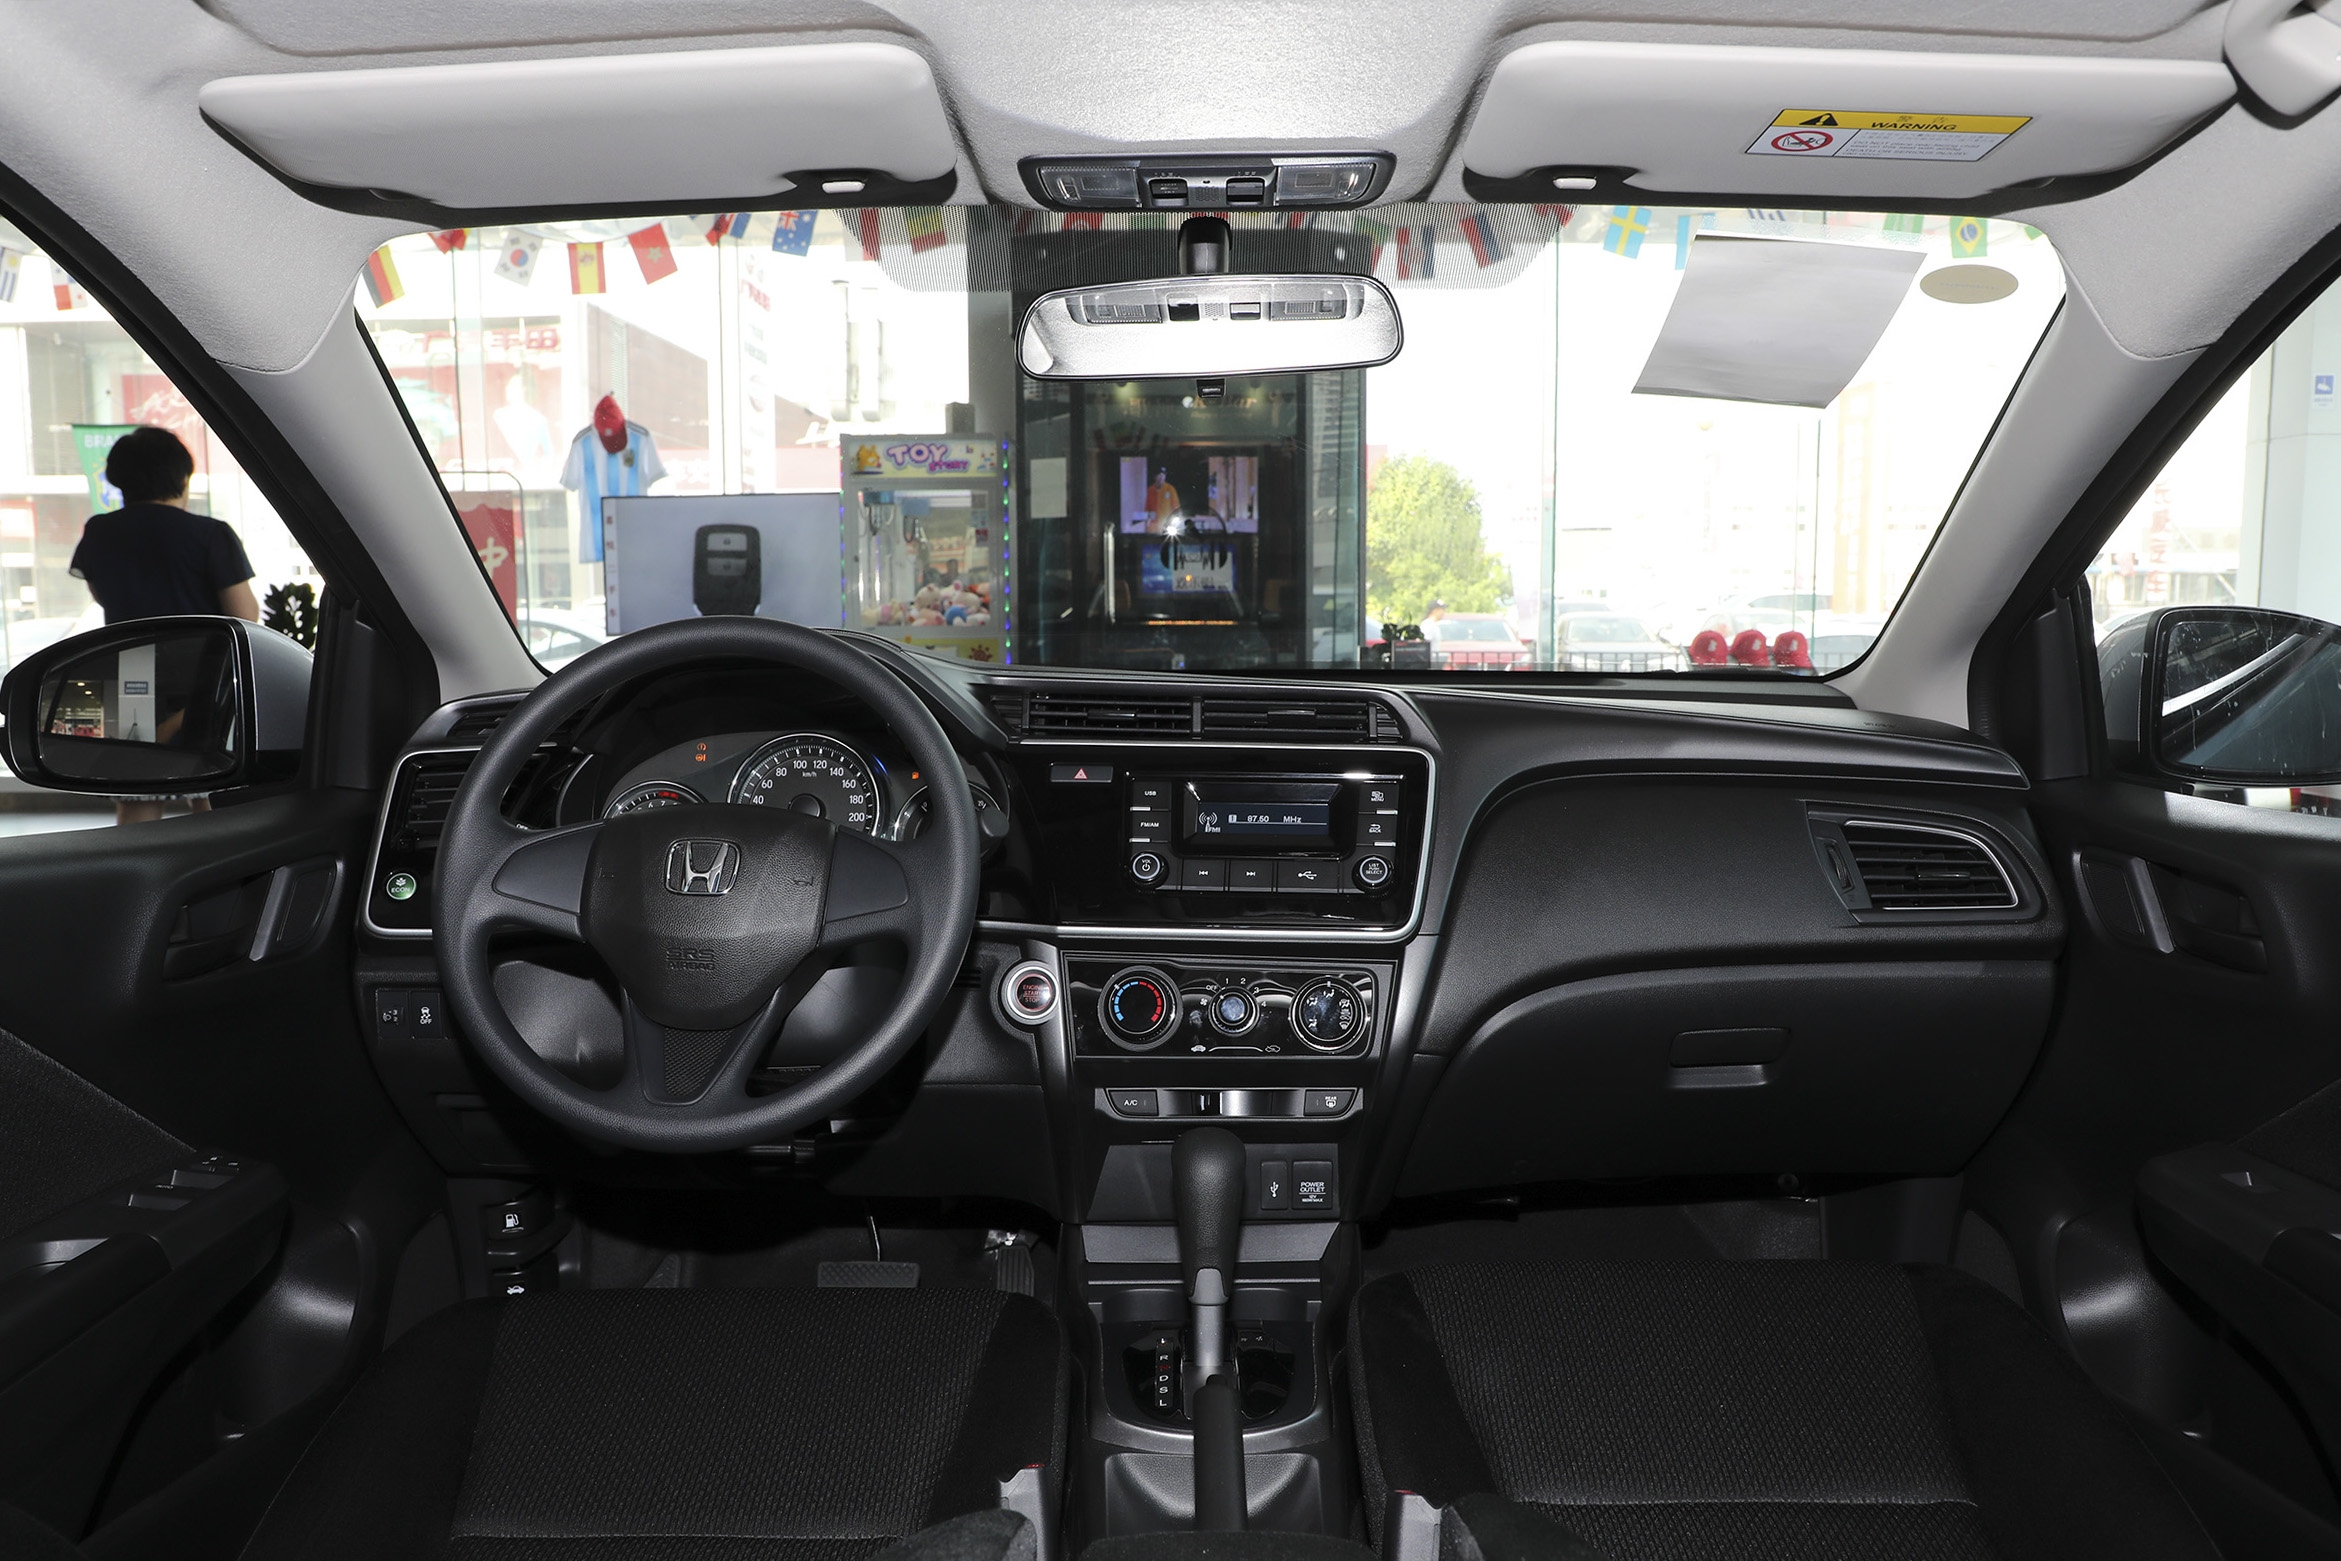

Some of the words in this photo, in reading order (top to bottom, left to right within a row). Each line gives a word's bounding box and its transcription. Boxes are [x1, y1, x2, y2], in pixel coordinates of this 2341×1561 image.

[1871, 122, 1958, 131] WARNING
[887, 443, 948, 466] TOY
[793, 760, 808, 769] 100
[813, 760, 828, 769] 120
[775, 767, 788, 777] 80
[829, 767, 844, 777] 140
[761, 779, 773, 789] 60
[842, 779, 856, 789] 160
[752, 795, 764, 805] 40
[849, 795, 864, 804] 180
[848, 812, 865, 822] 200
[1247, 815, 1269, 823] 87.50
[1159, 1374, 1169, 1382] D
[1159, 1386, 1169, 1394] S
[1159, 1399, 1168, 1407] L
